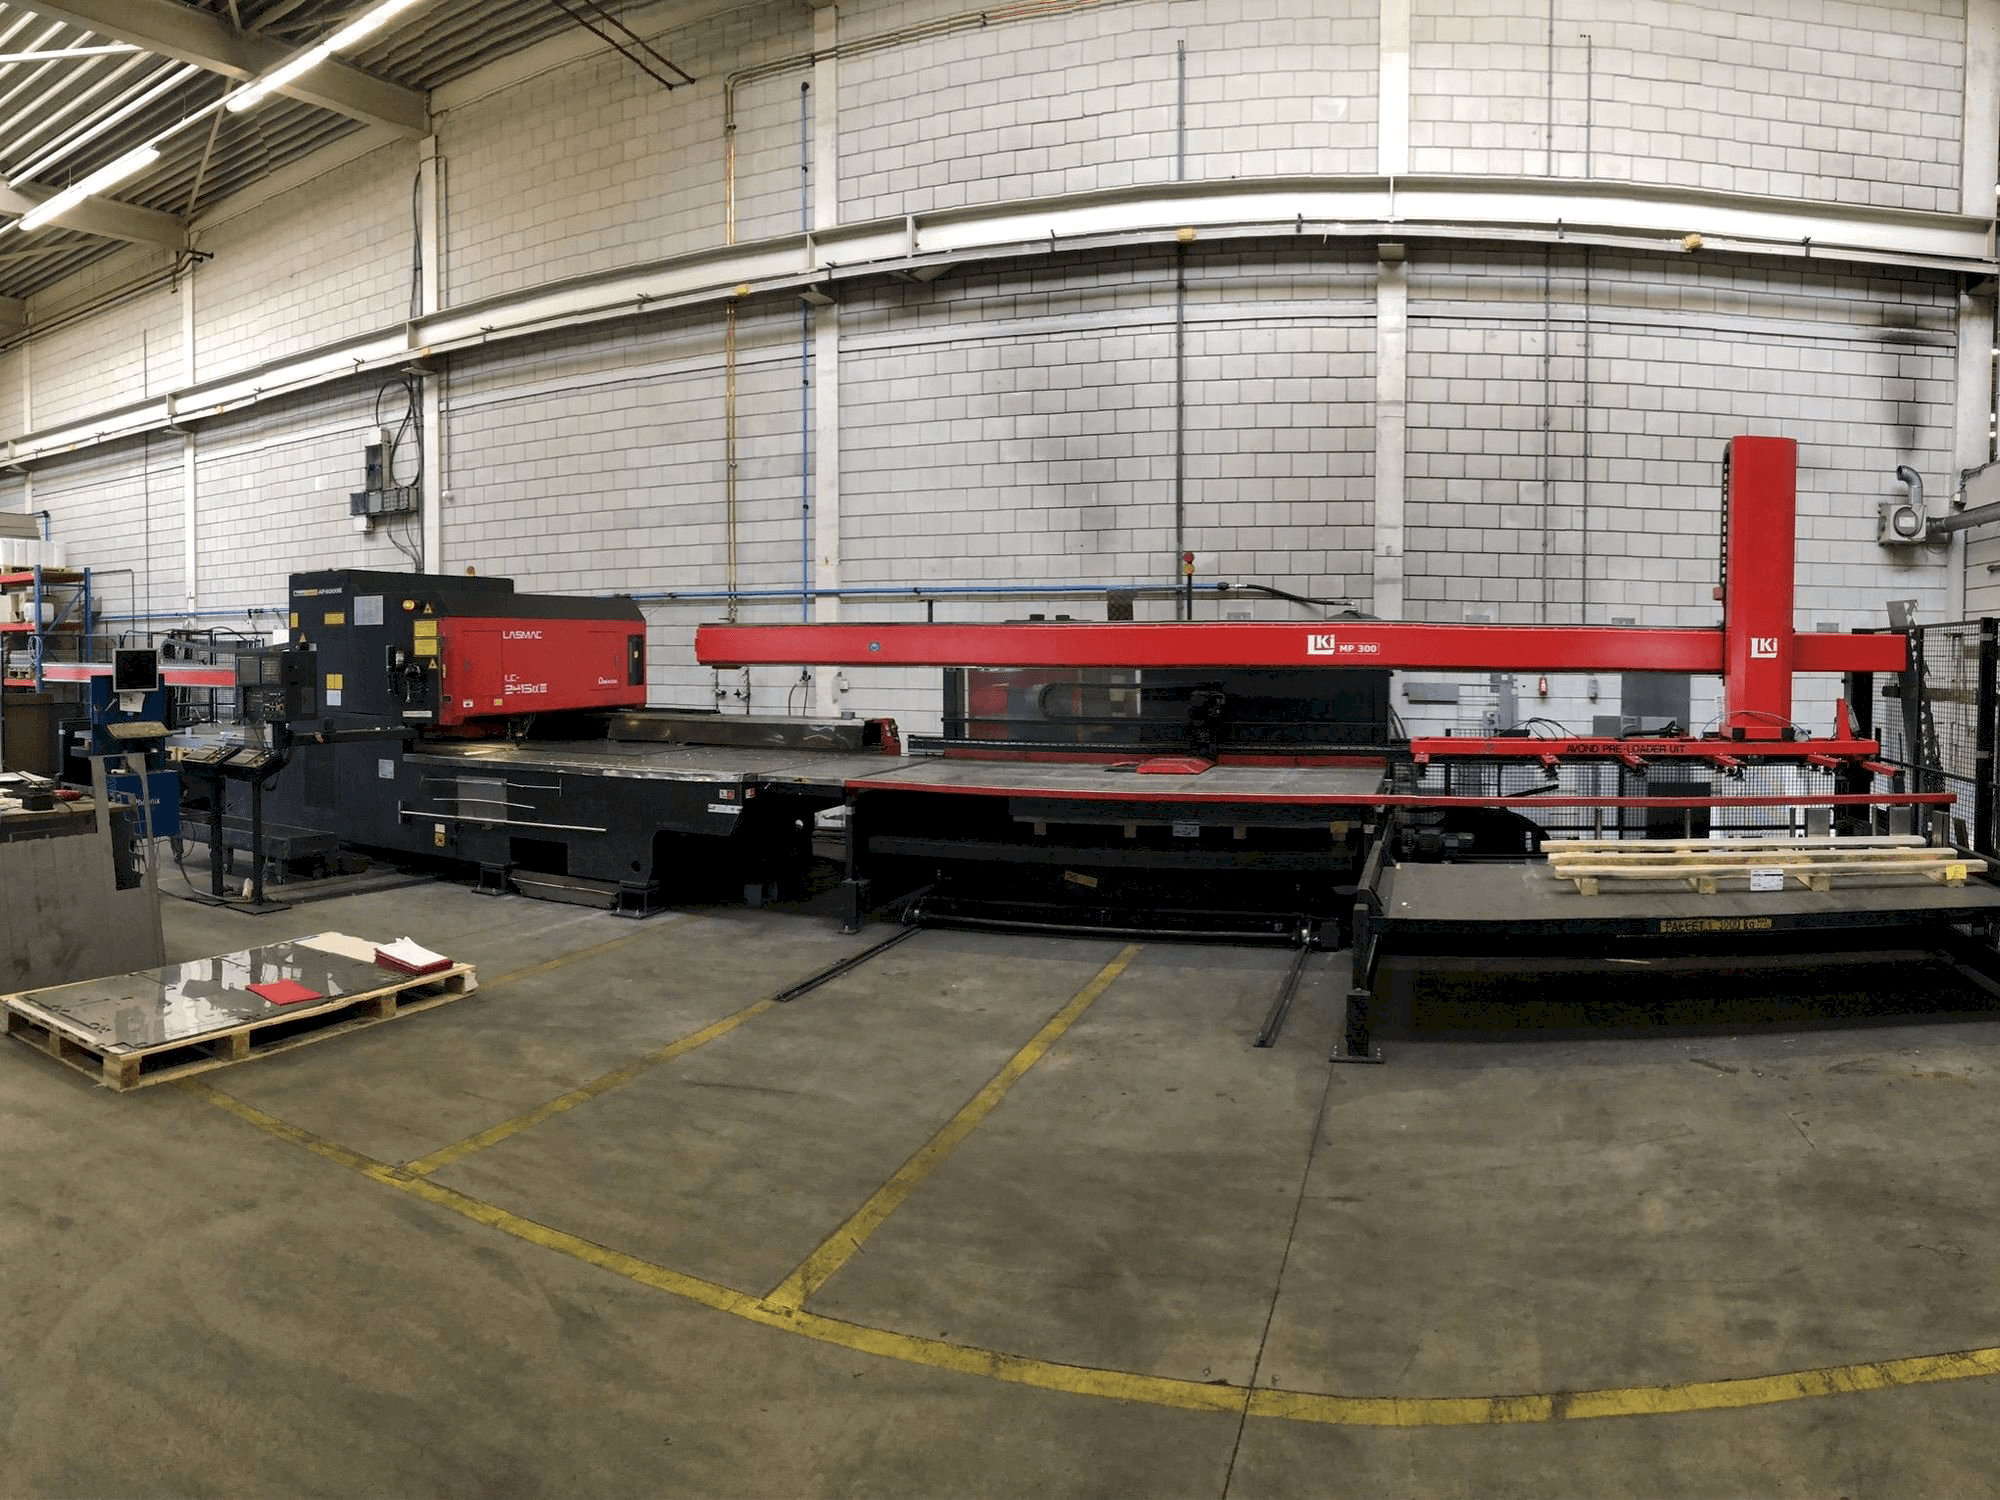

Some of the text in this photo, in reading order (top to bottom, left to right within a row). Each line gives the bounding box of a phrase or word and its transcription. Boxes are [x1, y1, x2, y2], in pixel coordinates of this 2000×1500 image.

[502, 630, 543, 640] LASMAC
[1339, 644, 1355, 653] MP
[1357, 644, 1378, 653] 300
